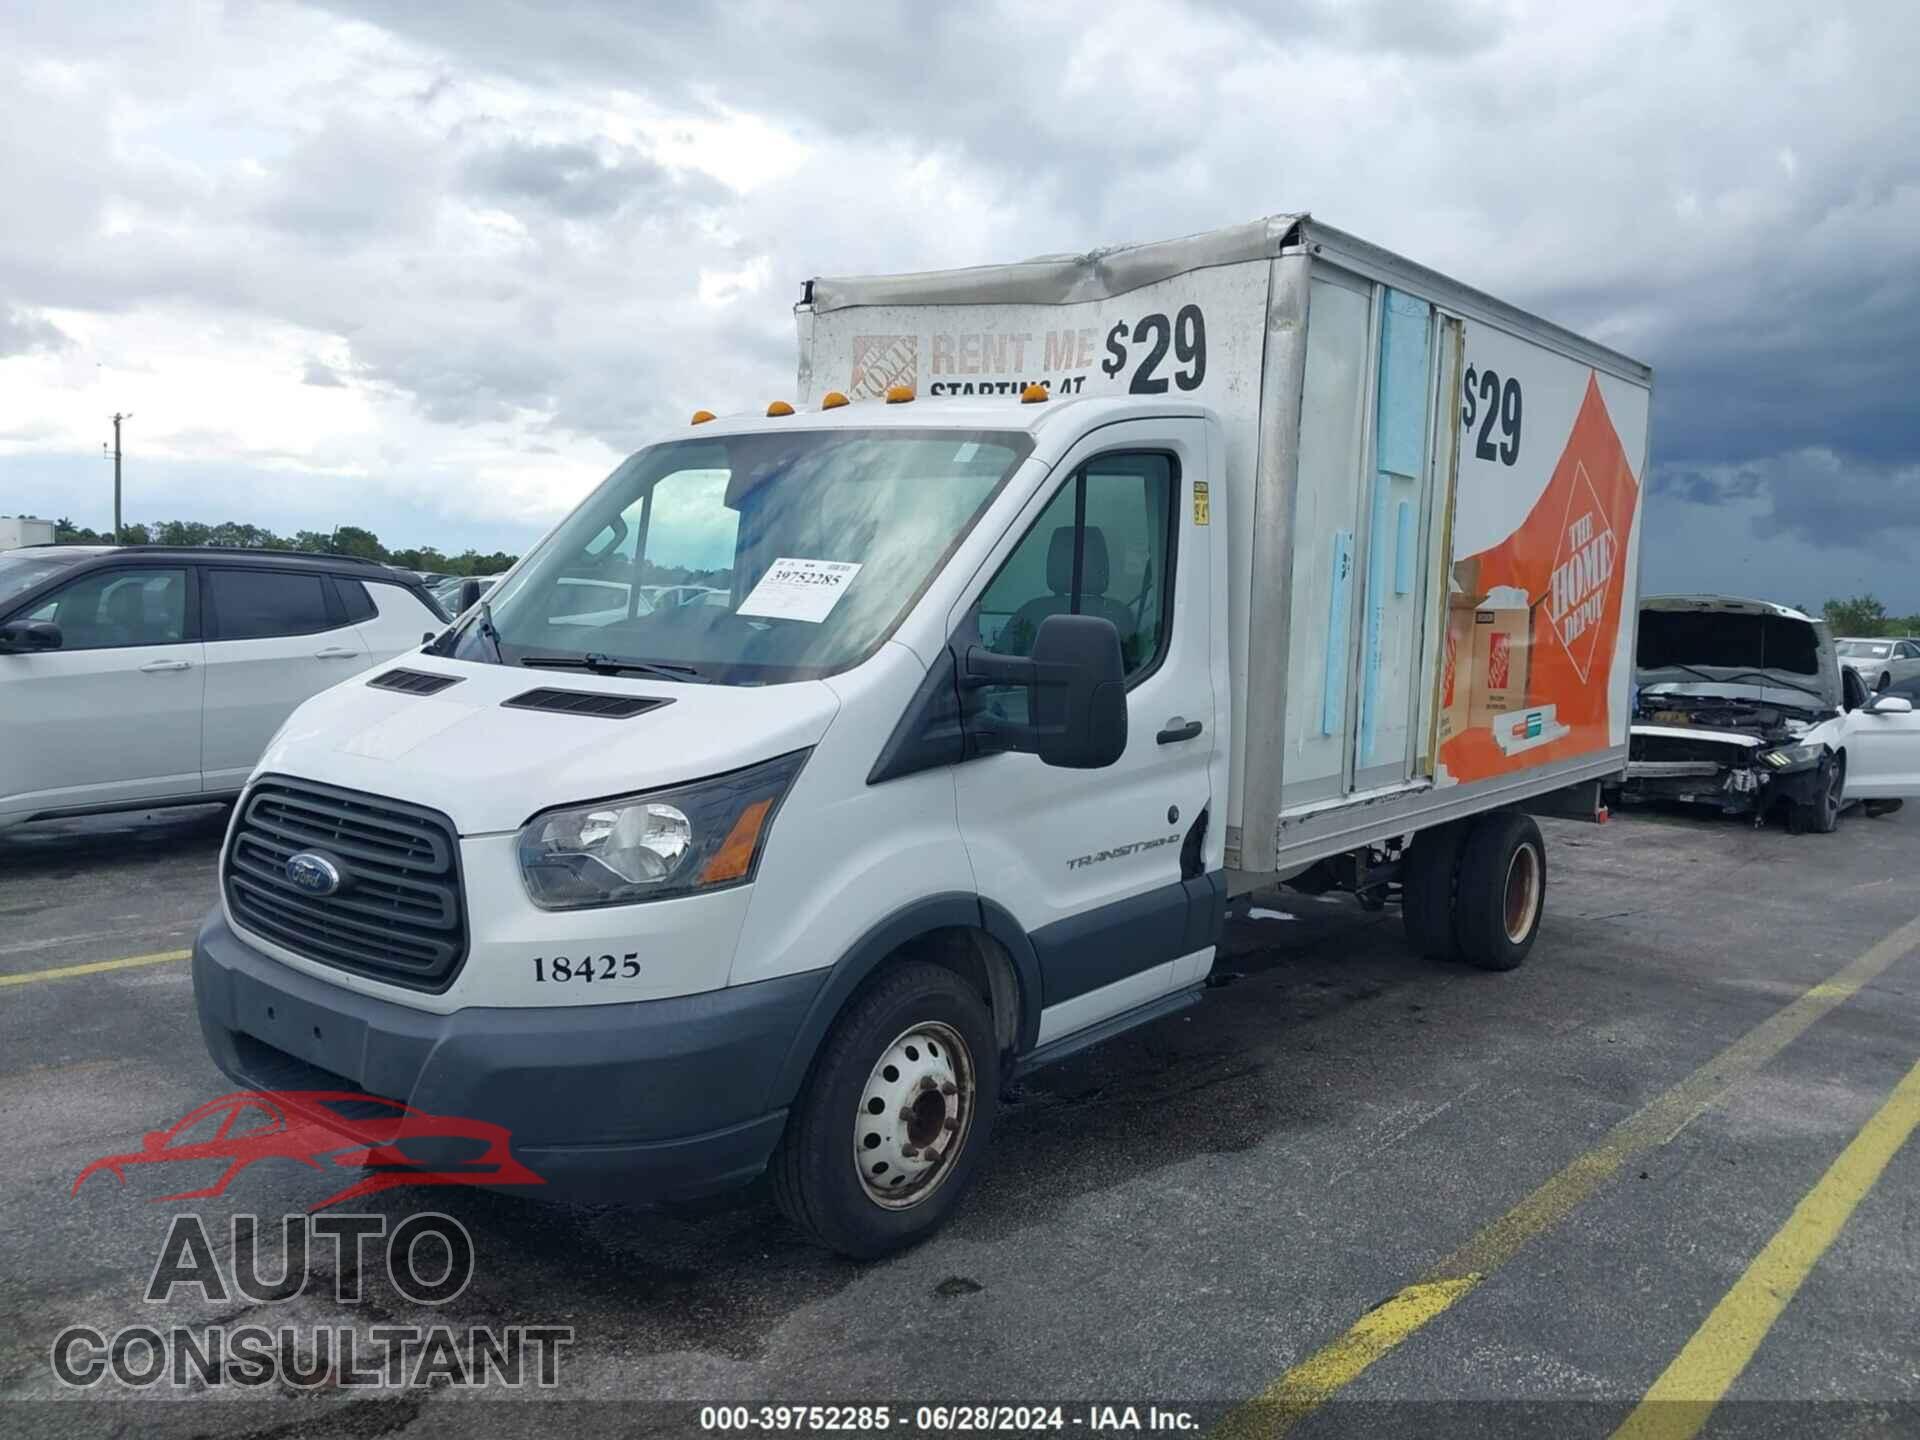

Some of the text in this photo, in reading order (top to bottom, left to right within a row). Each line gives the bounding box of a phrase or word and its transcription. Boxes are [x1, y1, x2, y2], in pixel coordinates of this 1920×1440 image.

[931, 304, 1208, 395] RENT ME $29
[1462, 362, 1523, 467] $29
[1569, 511, 1593, 552] THE
[771, 570, 842, 585] 39752285
[1552, 529, 1613, 623] HOME
[1564, 589, 1603, 647] DEPOT
[533, 952, 641, 983] 18425
